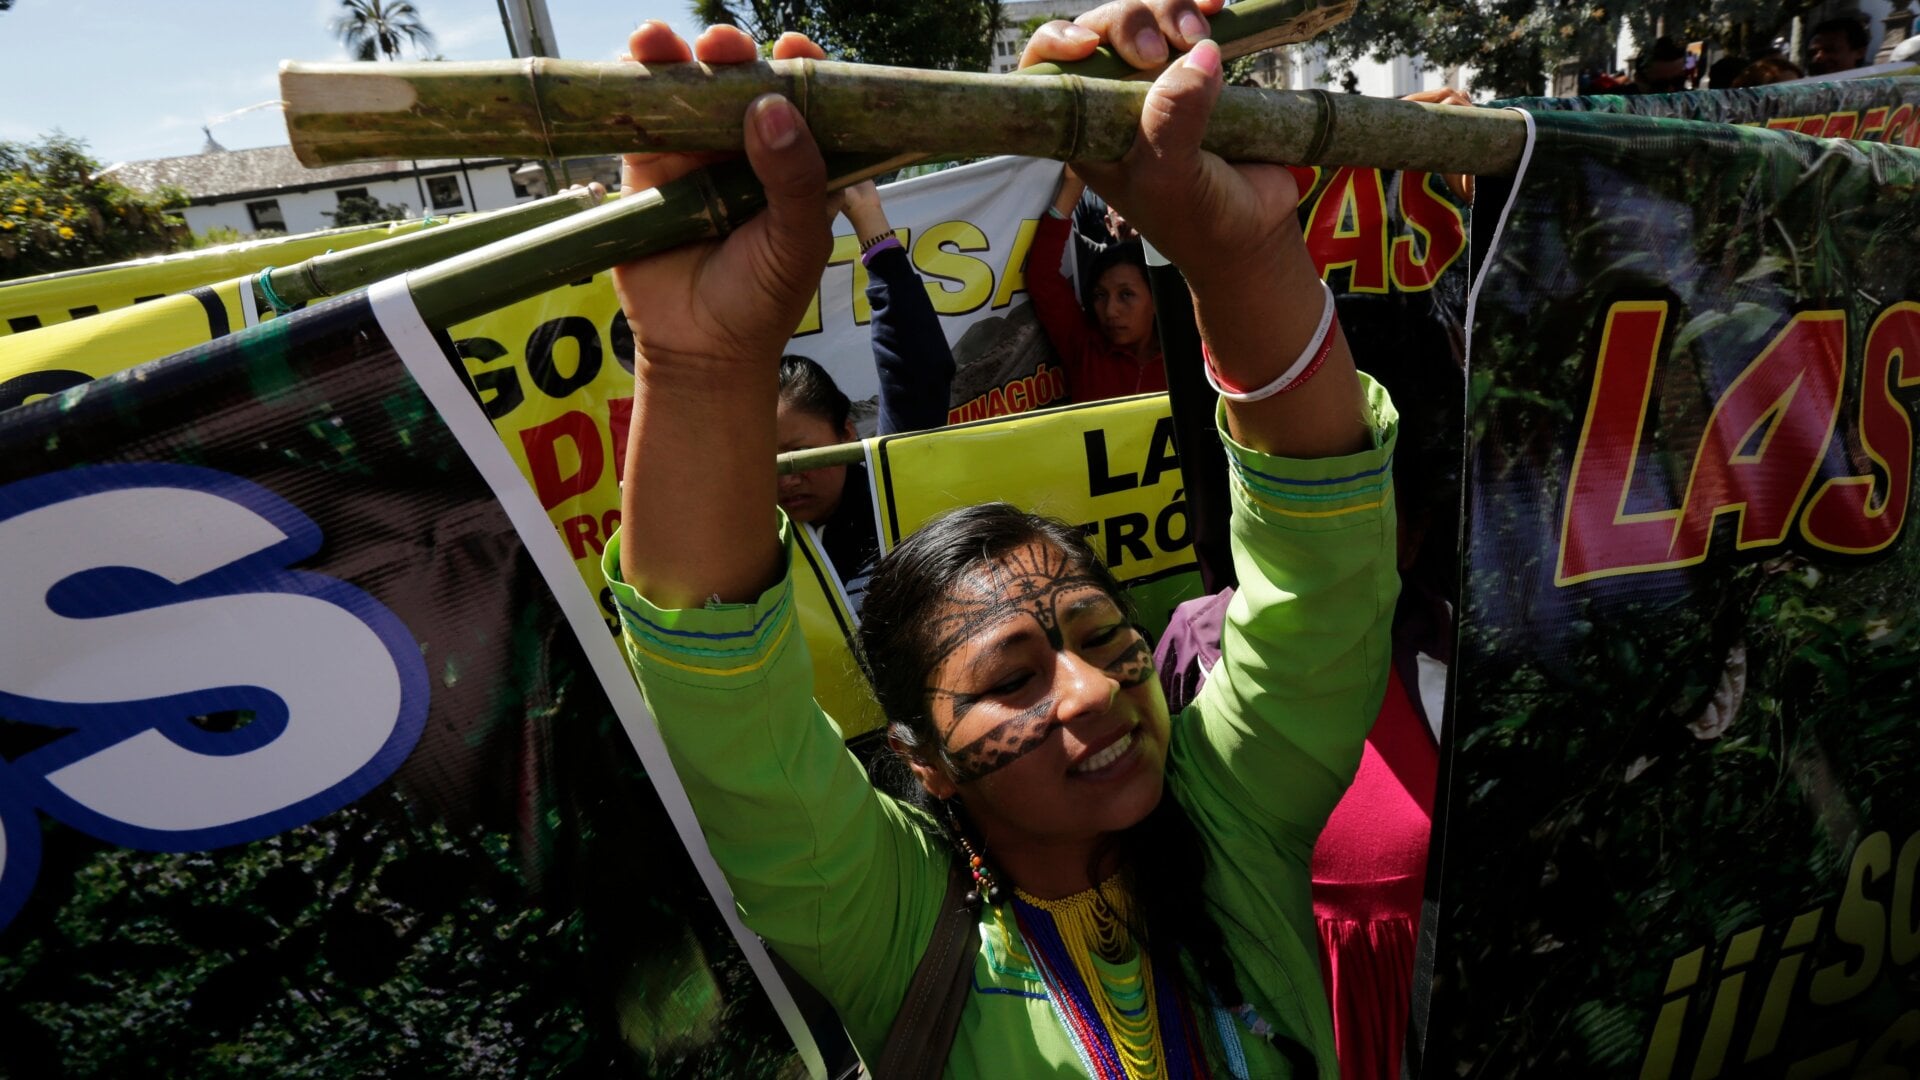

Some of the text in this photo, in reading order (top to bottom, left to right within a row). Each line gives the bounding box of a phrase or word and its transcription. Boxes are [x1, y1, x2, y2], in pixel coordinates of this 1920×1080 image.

[792, 220, 1040, 338] TSA
[1284, 166, 1467, 294] AS
[1554, 300, 1920, 587] LAS
